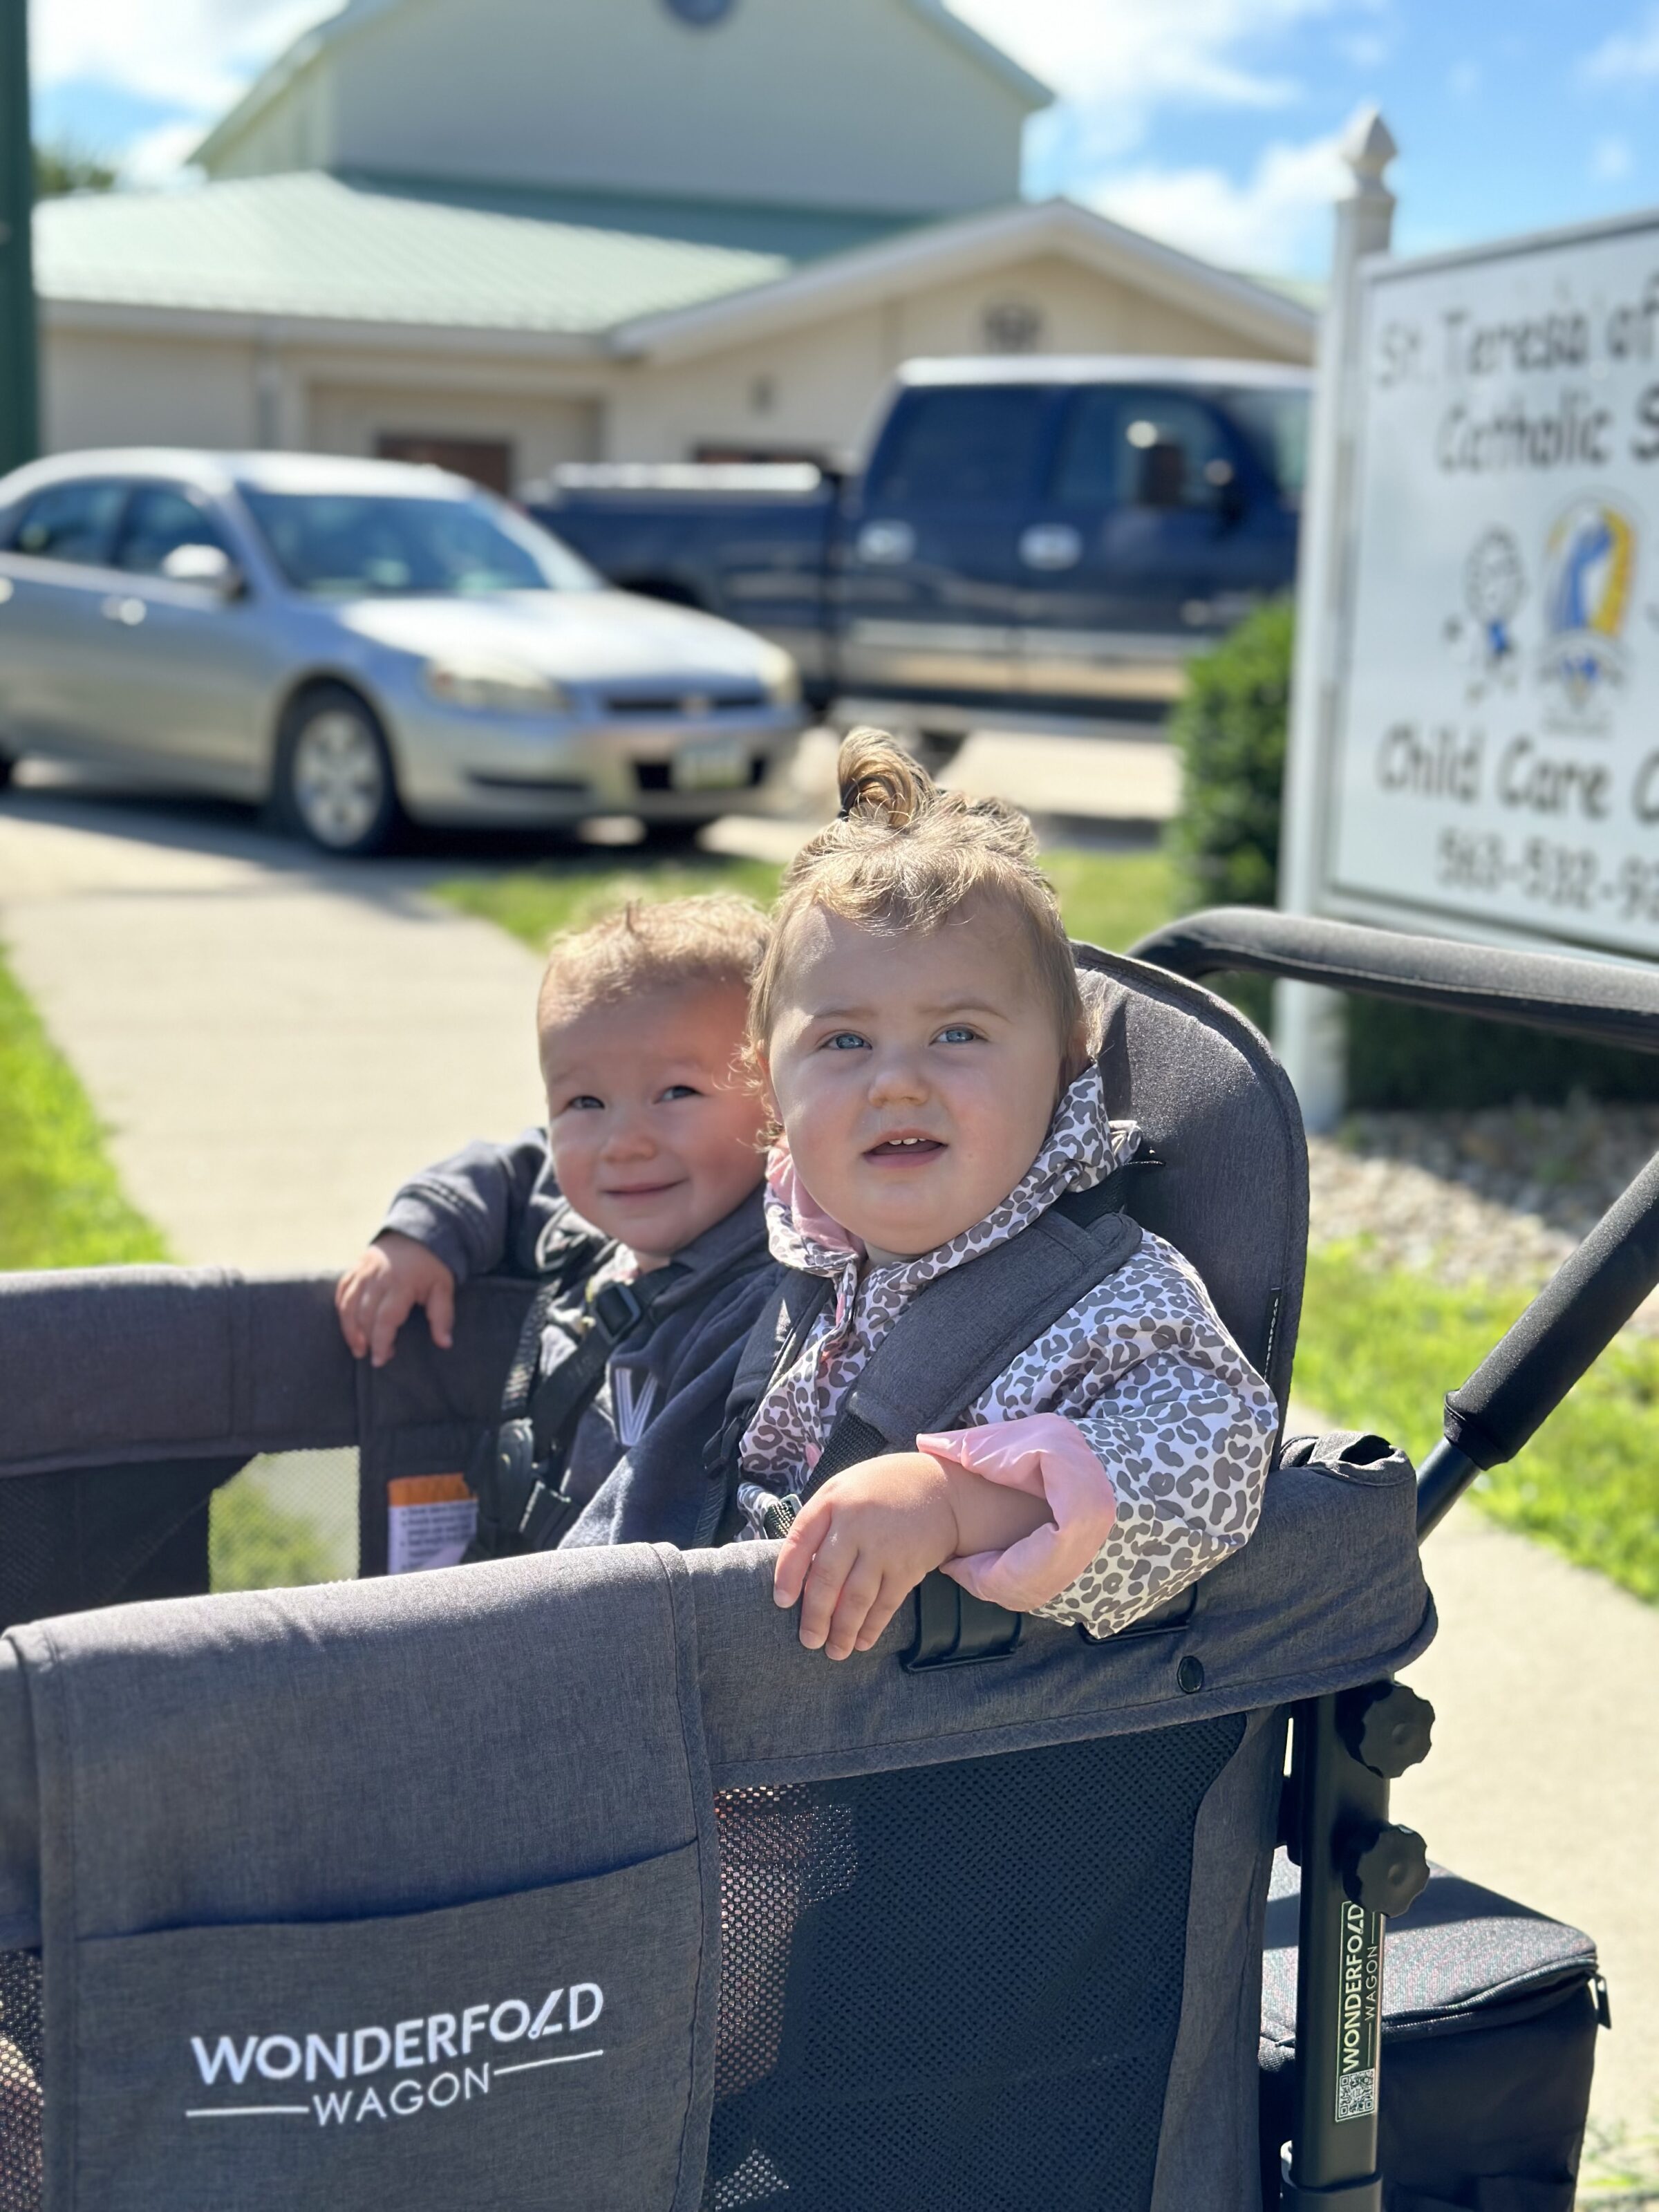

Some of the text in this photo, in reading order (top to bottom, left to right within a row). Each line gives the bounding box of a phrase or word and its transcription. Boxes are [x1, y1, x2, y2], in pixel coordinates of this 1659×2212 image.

[1443, 306, 1588, 375] Teresa
[1605, 270, 1659, 364] of
[1436, 391, 1611, 473] Catholic
[1378, 720, 1483, 804] Child
[1497, 734, 1609, 821] Care
[191, 1983, 604, 2084] WONDERFOLD
[1343, 1904, 1365, 2073] WONDERFOLD
[1365, 1945, 1378, 2021] WAGON
[313, 2062, 489, 2126] WAGON
